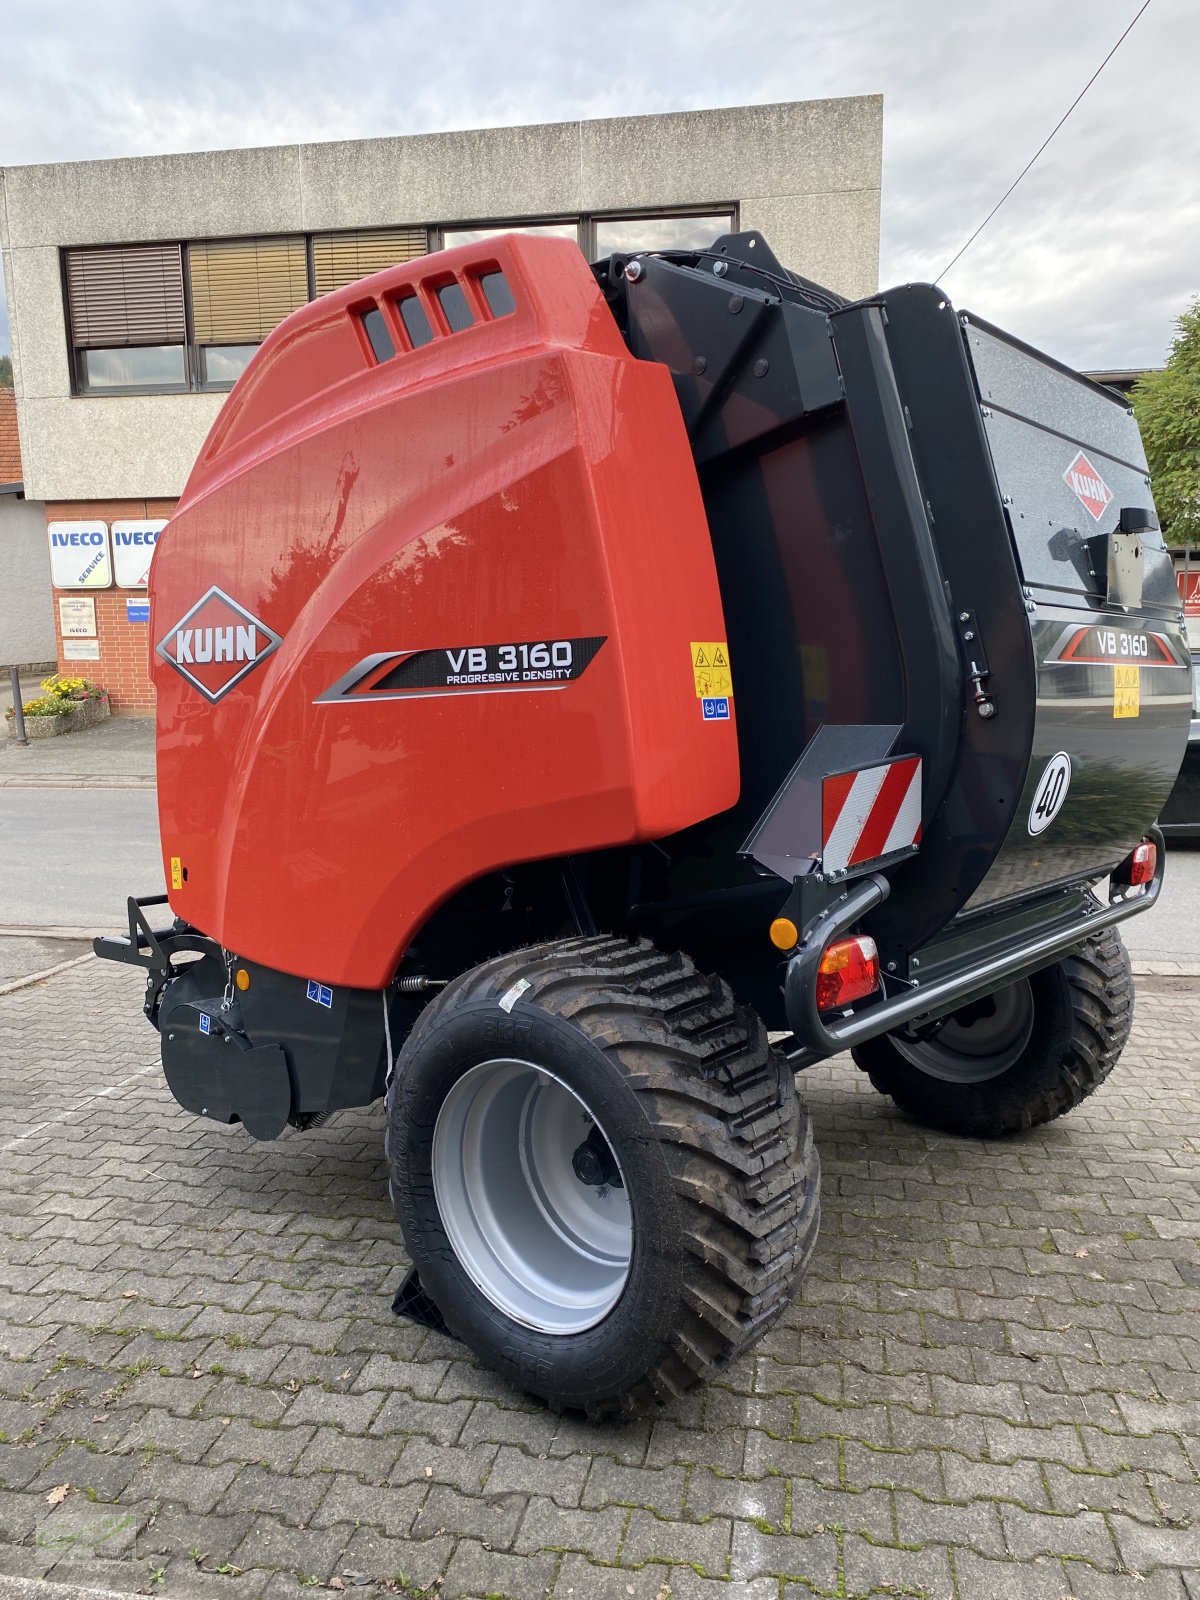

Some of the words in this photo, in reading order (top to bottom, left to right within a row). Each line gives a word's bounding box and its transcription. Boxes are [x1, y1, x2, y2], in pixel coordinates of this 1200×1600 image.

[1070, 471, 1108, 504] KUHN
[52, 532, 104, 546] IVECO
[78, 551, 105, 584] SERVICE
[176, 624, 256, 664] KUHN
[445, 648, 487, 673] VB
[498, 641, 573, 670] 3160
[1097, 631, 1117, 655] VB
[1120, 634, 1148, 657] 3160
[446, 671, 520, 685] PROGRESSIVE
[522, 668, 573, 681] DENSITY
[1035, 766, 1066, 820] 40
